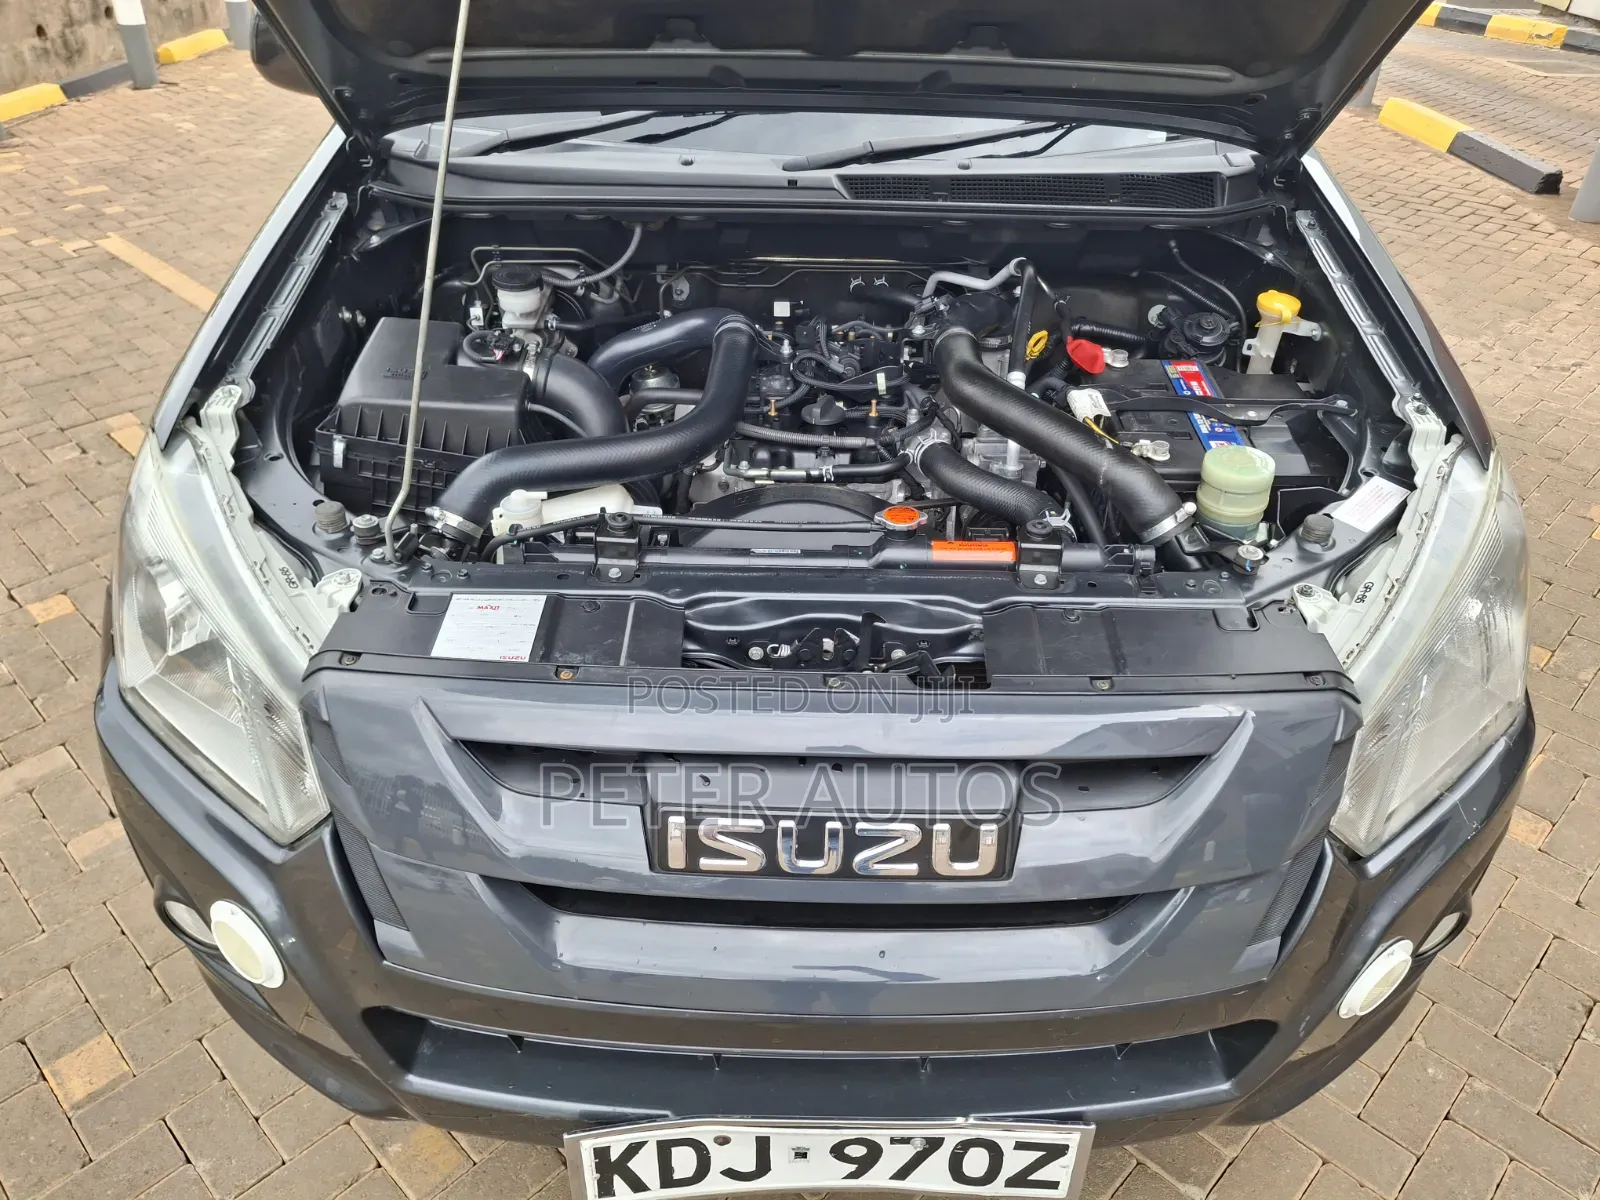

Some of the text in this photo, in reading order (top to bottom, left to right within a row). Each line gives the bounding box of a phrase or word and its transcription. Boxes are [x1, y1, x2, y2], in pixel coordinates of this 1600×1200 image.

[666, 813, 998, 877] ISUZU
[593, 1136, 1070, 1199] KDJ 970Z
